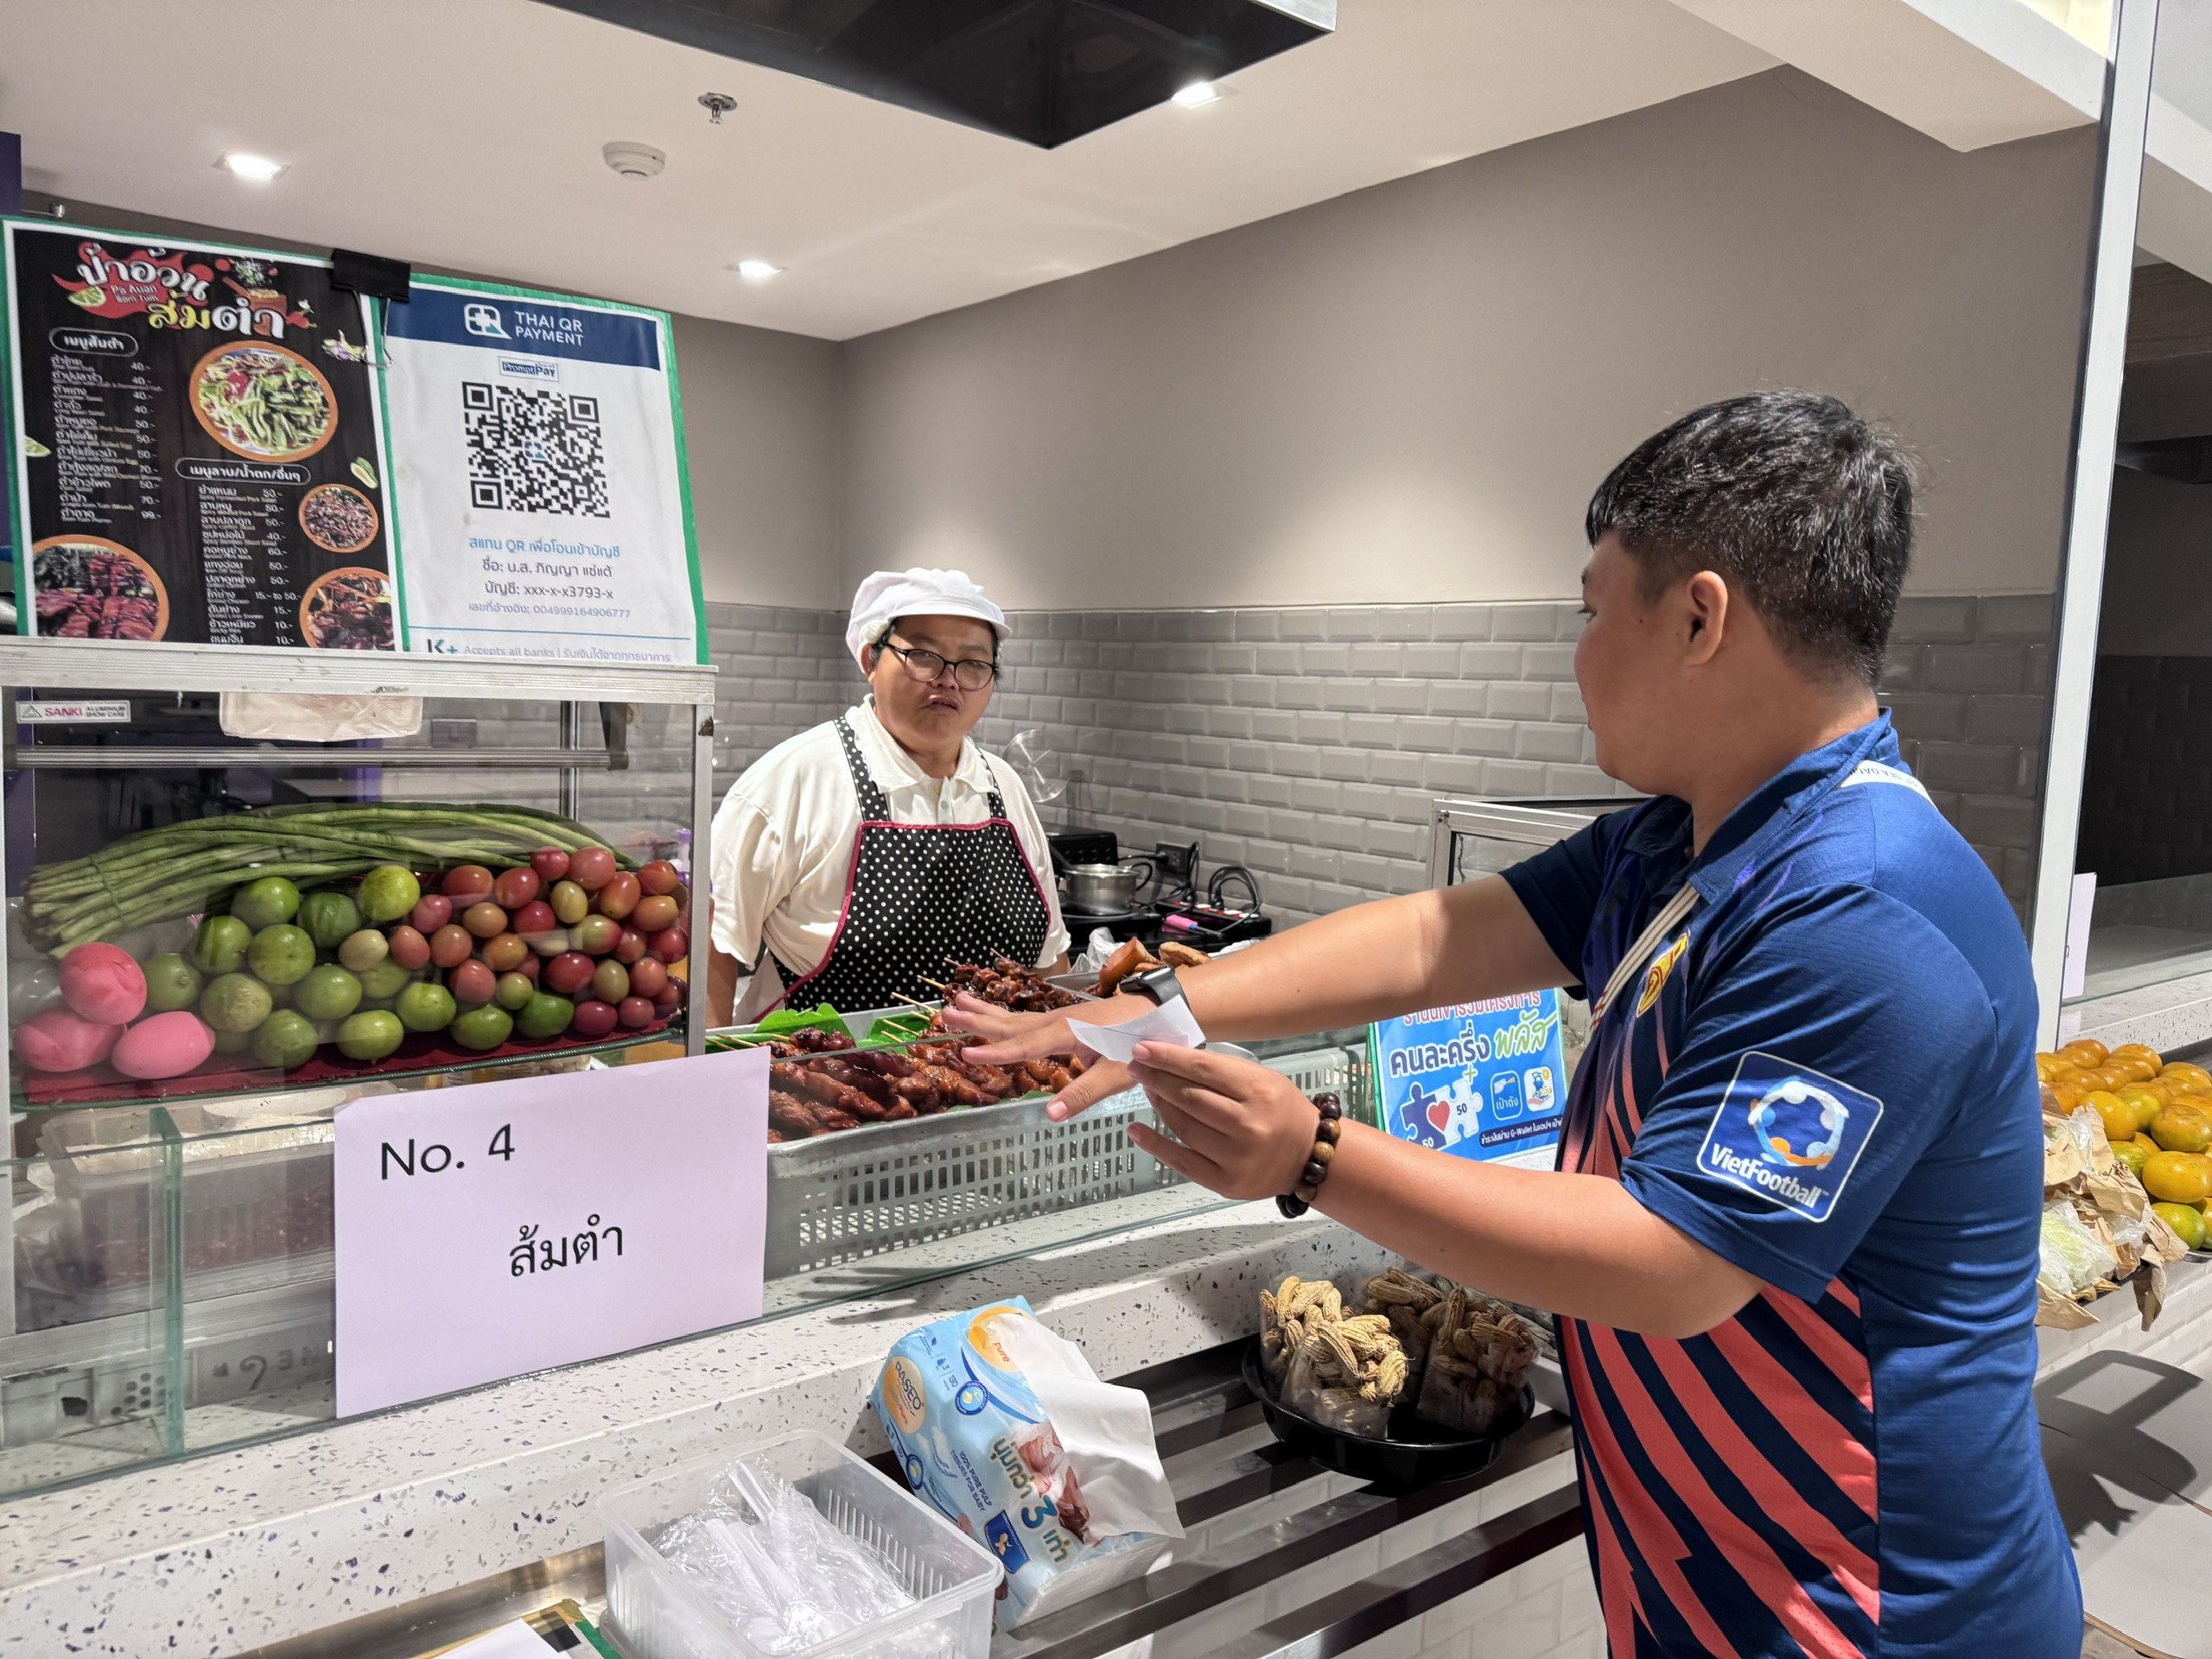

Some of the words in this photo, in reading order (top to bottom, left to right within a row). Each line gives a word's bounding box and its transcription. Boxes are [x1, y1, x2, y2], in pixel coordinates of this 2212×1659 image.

[147, 288, 285, 340] ส้มตำ
[514, 310, 555, 329] THAI
[558, 317, 583, 333] QR
[515, 325, 585, 346] PAYMENT
[469, 537, 503, 550] สแกน
[506, 539, 526, 553] QR
[529, 537, 620, 558] เพื่อโอนเข้าบัญชี
[482, 556, 504, 573] ชื่อ:
[507, 562, 532, 575] น.ส.
[484, 580, 520, 596] บัญชี:
[524, 586, 613, 599] xxx-x-x3793-x
[464, 645, 506, 656] Accepts
[509, 647, 522, 656] all
[524, 647, 555, 658] banks
[44, 708, 83, 716] SANKI
[1390, 1020, 1491, 1077] คนละครึ่ง
[1494, 1010, 1559, 1058] พลัส
[1456, 1103, 1468, 1116] 50
[1422, 1137, 1434, 1147] 50
[1510, 1126, 1532, 1138] G-Wallet
[381, 1137, 465, 1180] No.
[487, 1123, 516, 1161] 4
[1711, 1142, 1822, 1209] VietFootball
[508, 1213, 624, 1278] ส้มตำ
[950, 1448, 966, 1475] TISSUES
[963, 1476, 974, 1491] FOR
[971, 1490, 986, 1511] BABY
[959, 1450, 971, 1469] 100%
[969, 1469, 982, 1488] PURE
[978, 1489, 993, 1507] PULP
[988, 1436, 1033, 1500] นุ่มกว่า
[1020, 1494, 1059, 1529] 3
[1042, 1529, 1069, 1564] เท่า
